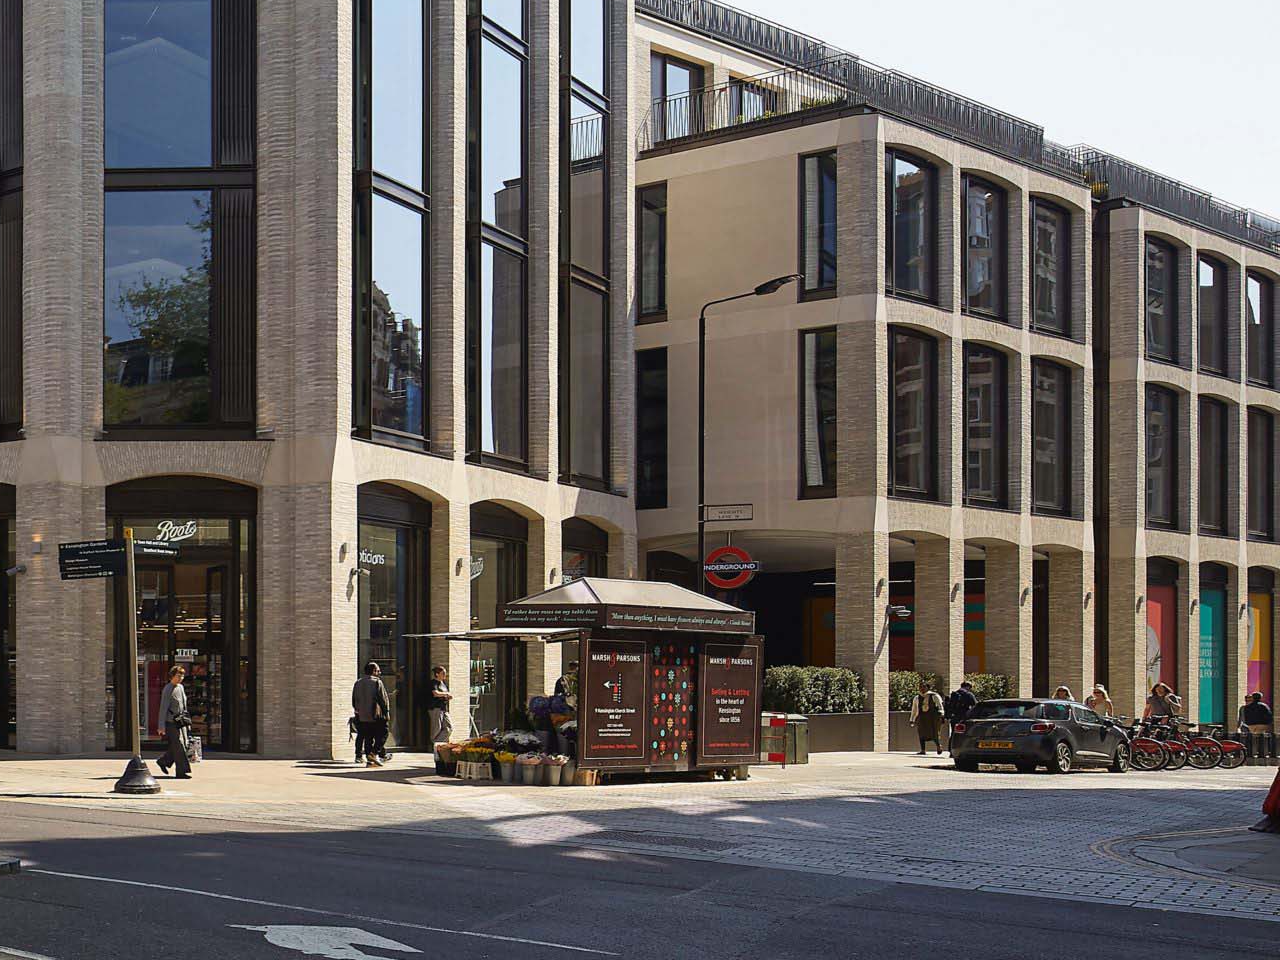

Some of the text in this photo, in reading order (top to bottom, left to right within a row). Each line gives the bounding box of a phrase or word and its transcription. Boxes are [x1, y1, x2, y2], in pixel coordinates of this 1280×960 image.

[156, 520, 197, 541] Boots
[616, 654, 641, 662] PARSONS
[731, 657, 753, 666] PARSONS
[719, 707, 741, 715] Kensington
